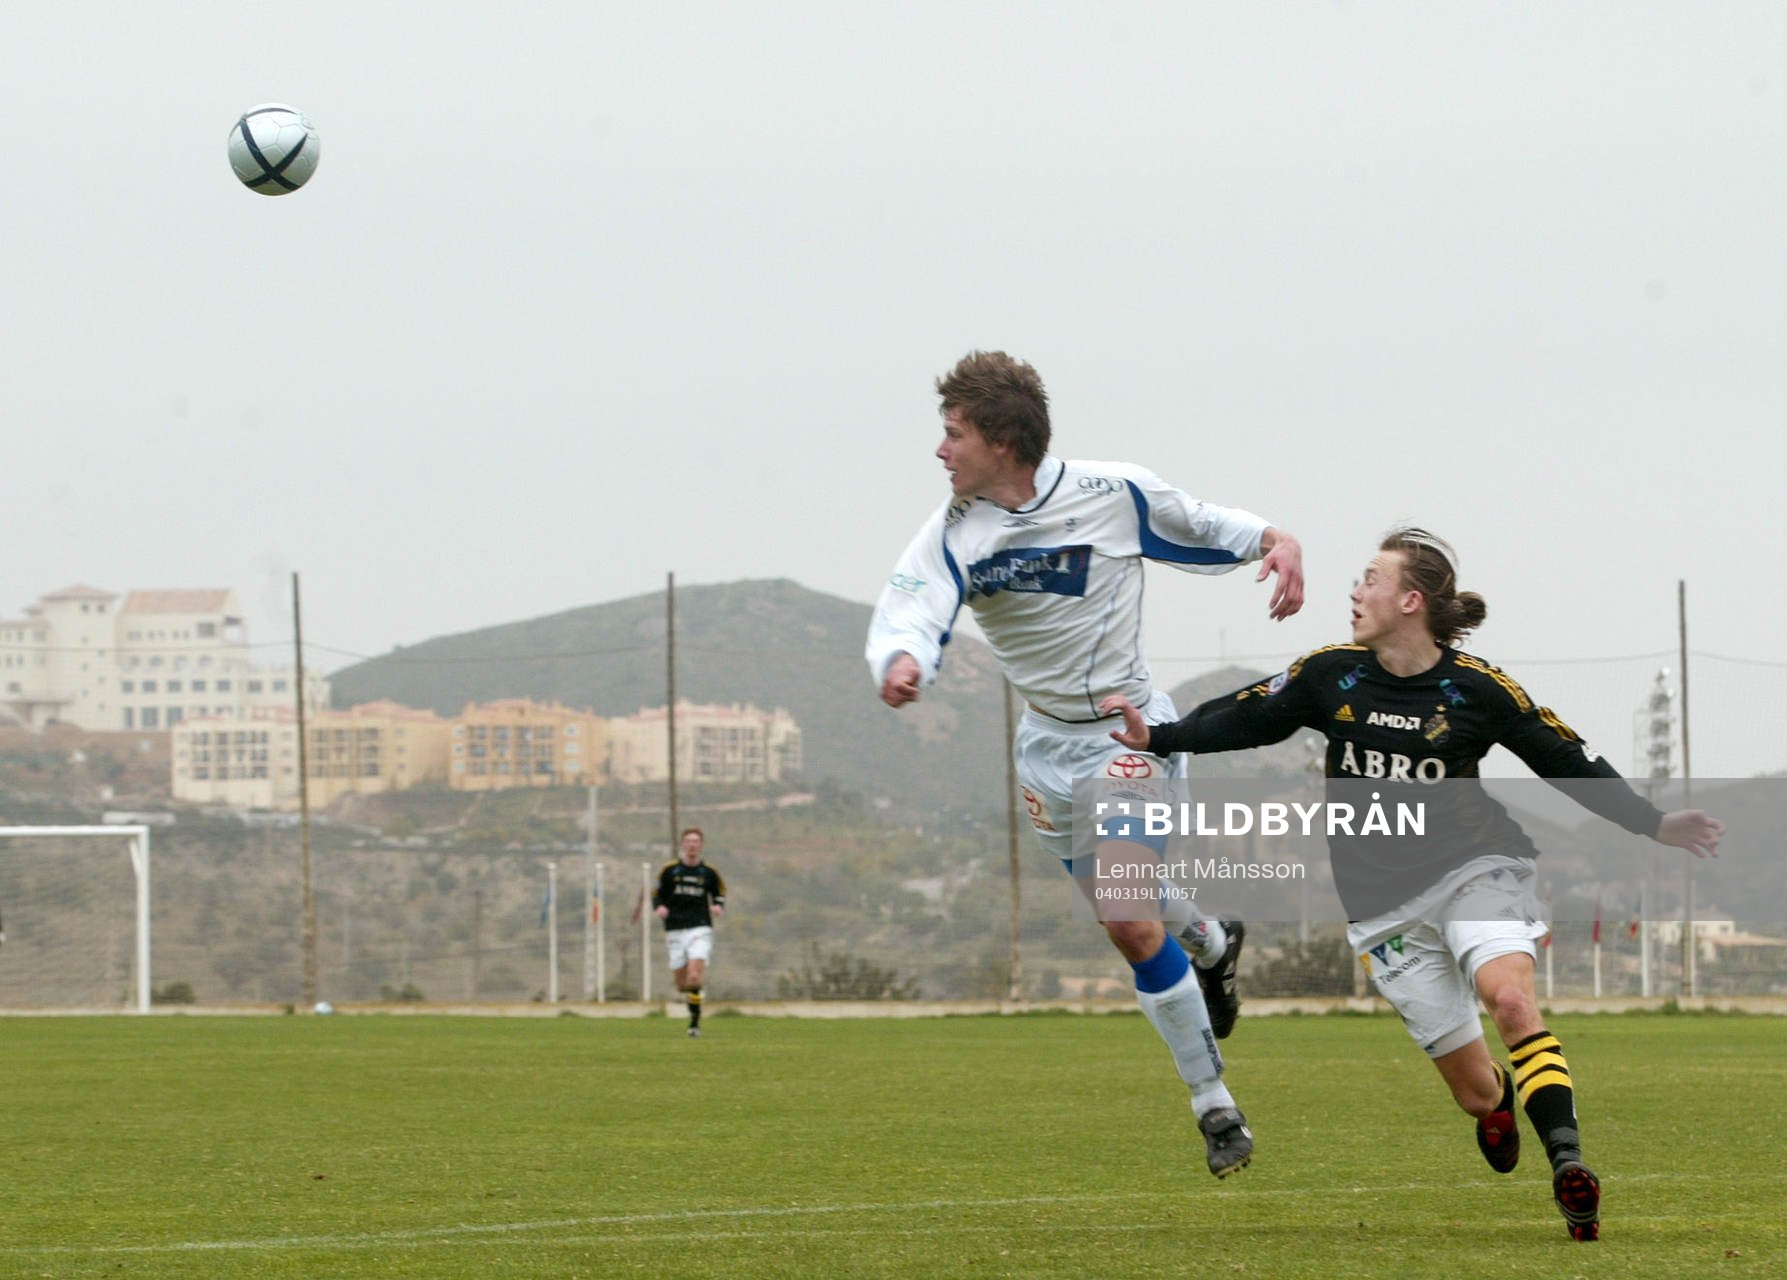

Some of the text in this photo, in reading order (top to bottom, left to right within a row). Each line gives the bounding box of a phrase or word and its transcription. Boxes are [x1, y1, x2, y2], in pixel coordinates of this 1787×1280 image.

[1366, 711, 1406, 729] AMD
[1341, 741, 1446, 785] ÅBRO
[1104, 780, 1158, 797] OYOTA
